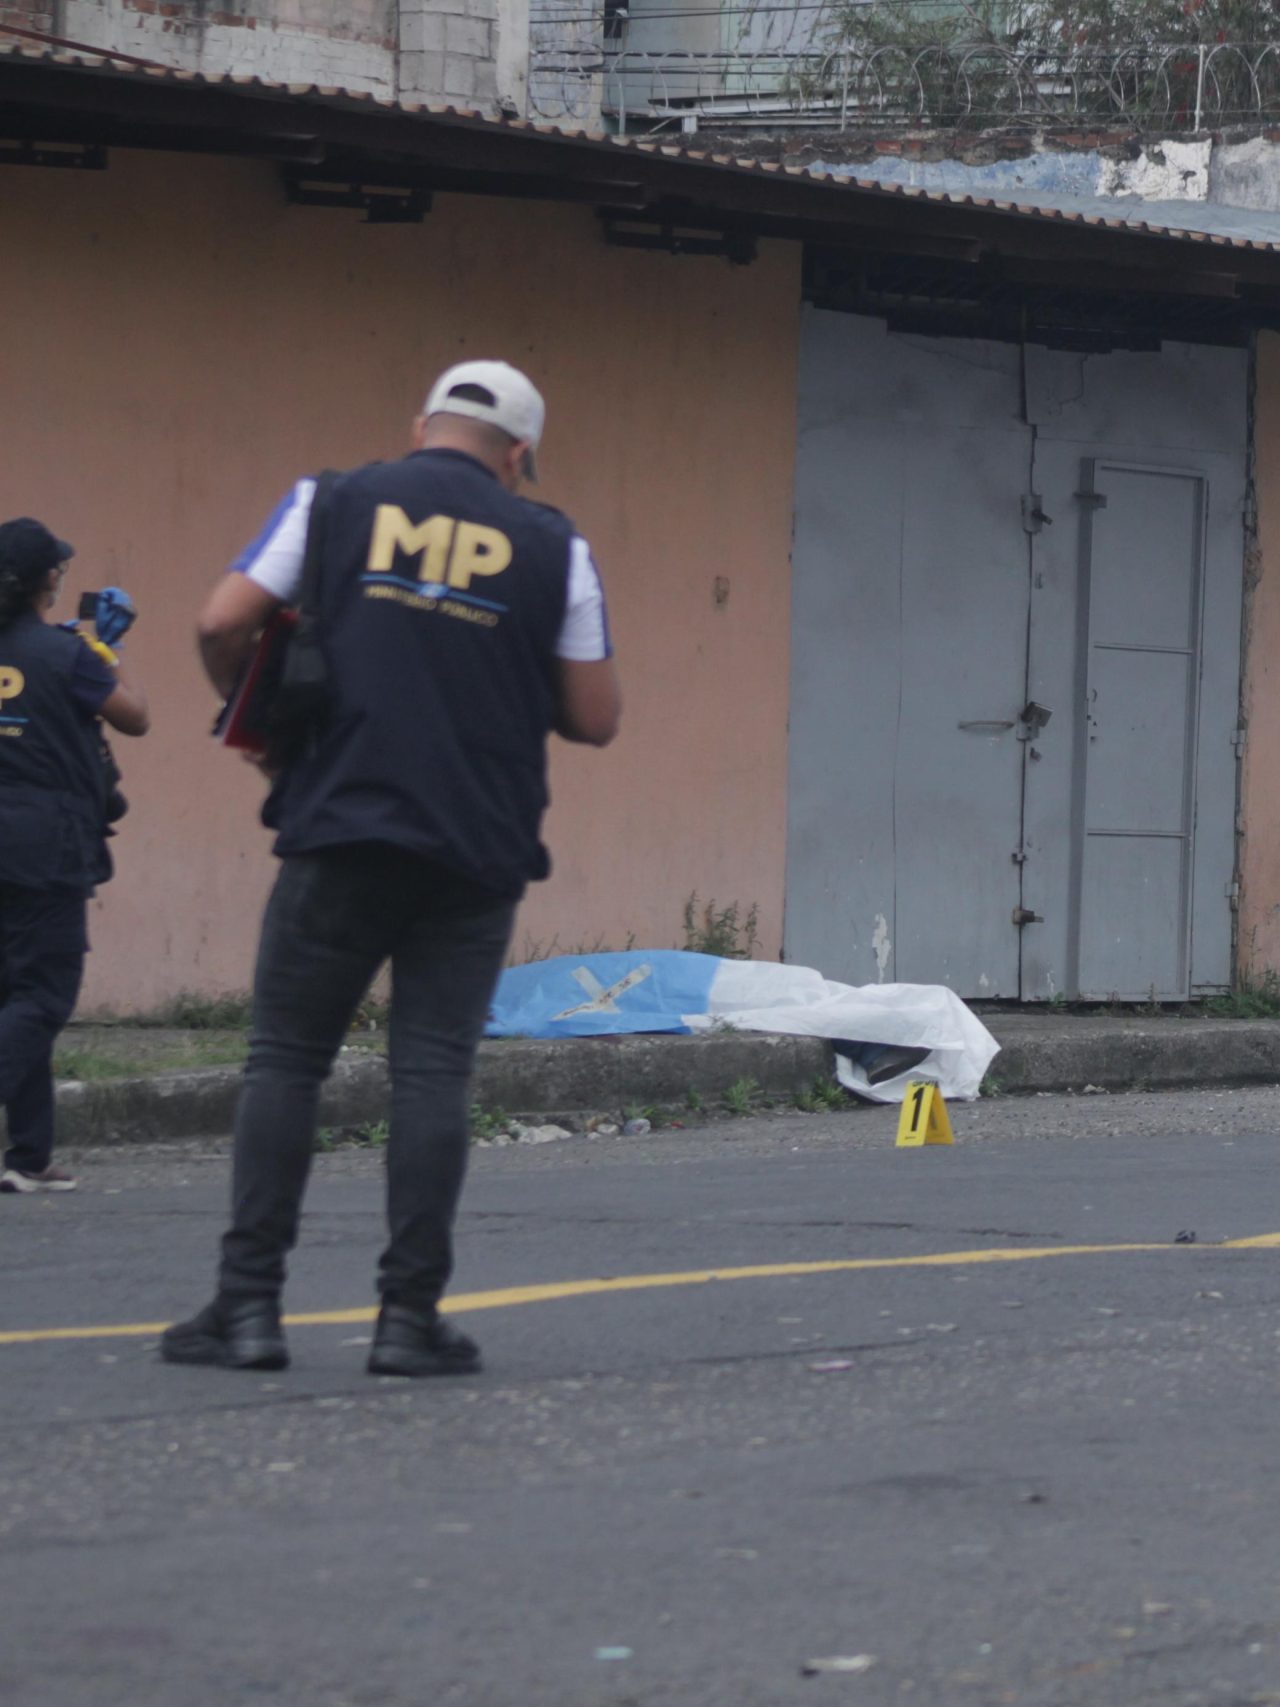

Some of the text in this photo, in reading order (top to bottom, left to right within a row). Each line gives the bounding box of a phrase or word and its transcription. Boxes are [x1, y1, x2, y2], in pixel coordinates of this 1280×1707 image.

[366, 504, 513, 590] MP
[0, 665, 25, 710] P
[911, 1087, 925, 1132] 1
